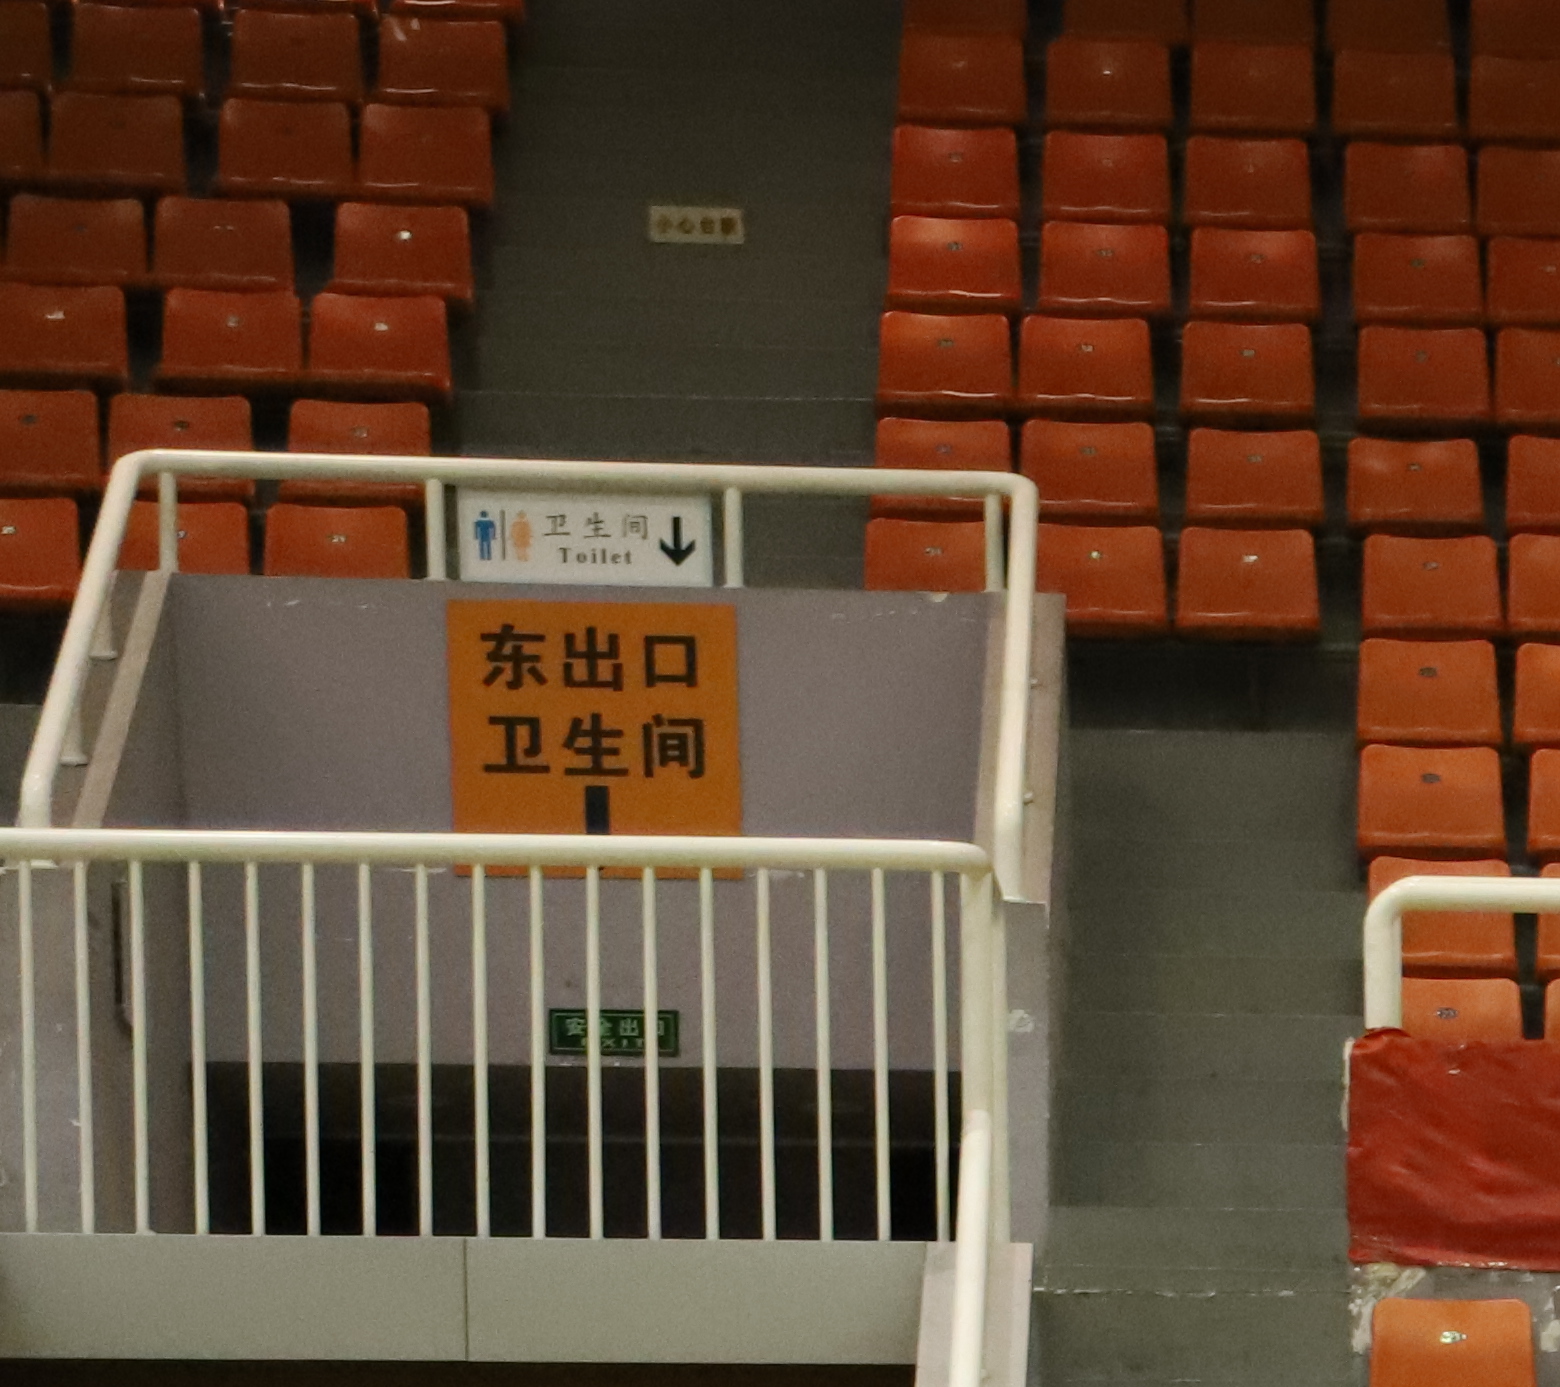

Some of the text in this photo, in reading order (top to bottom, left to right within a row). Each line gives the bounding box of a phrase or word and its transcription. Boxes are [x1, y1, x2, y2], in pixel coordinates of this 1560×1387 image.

[544, 512, 649, 540] 卫生间
[559, 548, 633, 565] Toilet
[480, 624, 698, 692] 东出口
[482, 713, 706, 779] 卫生间
